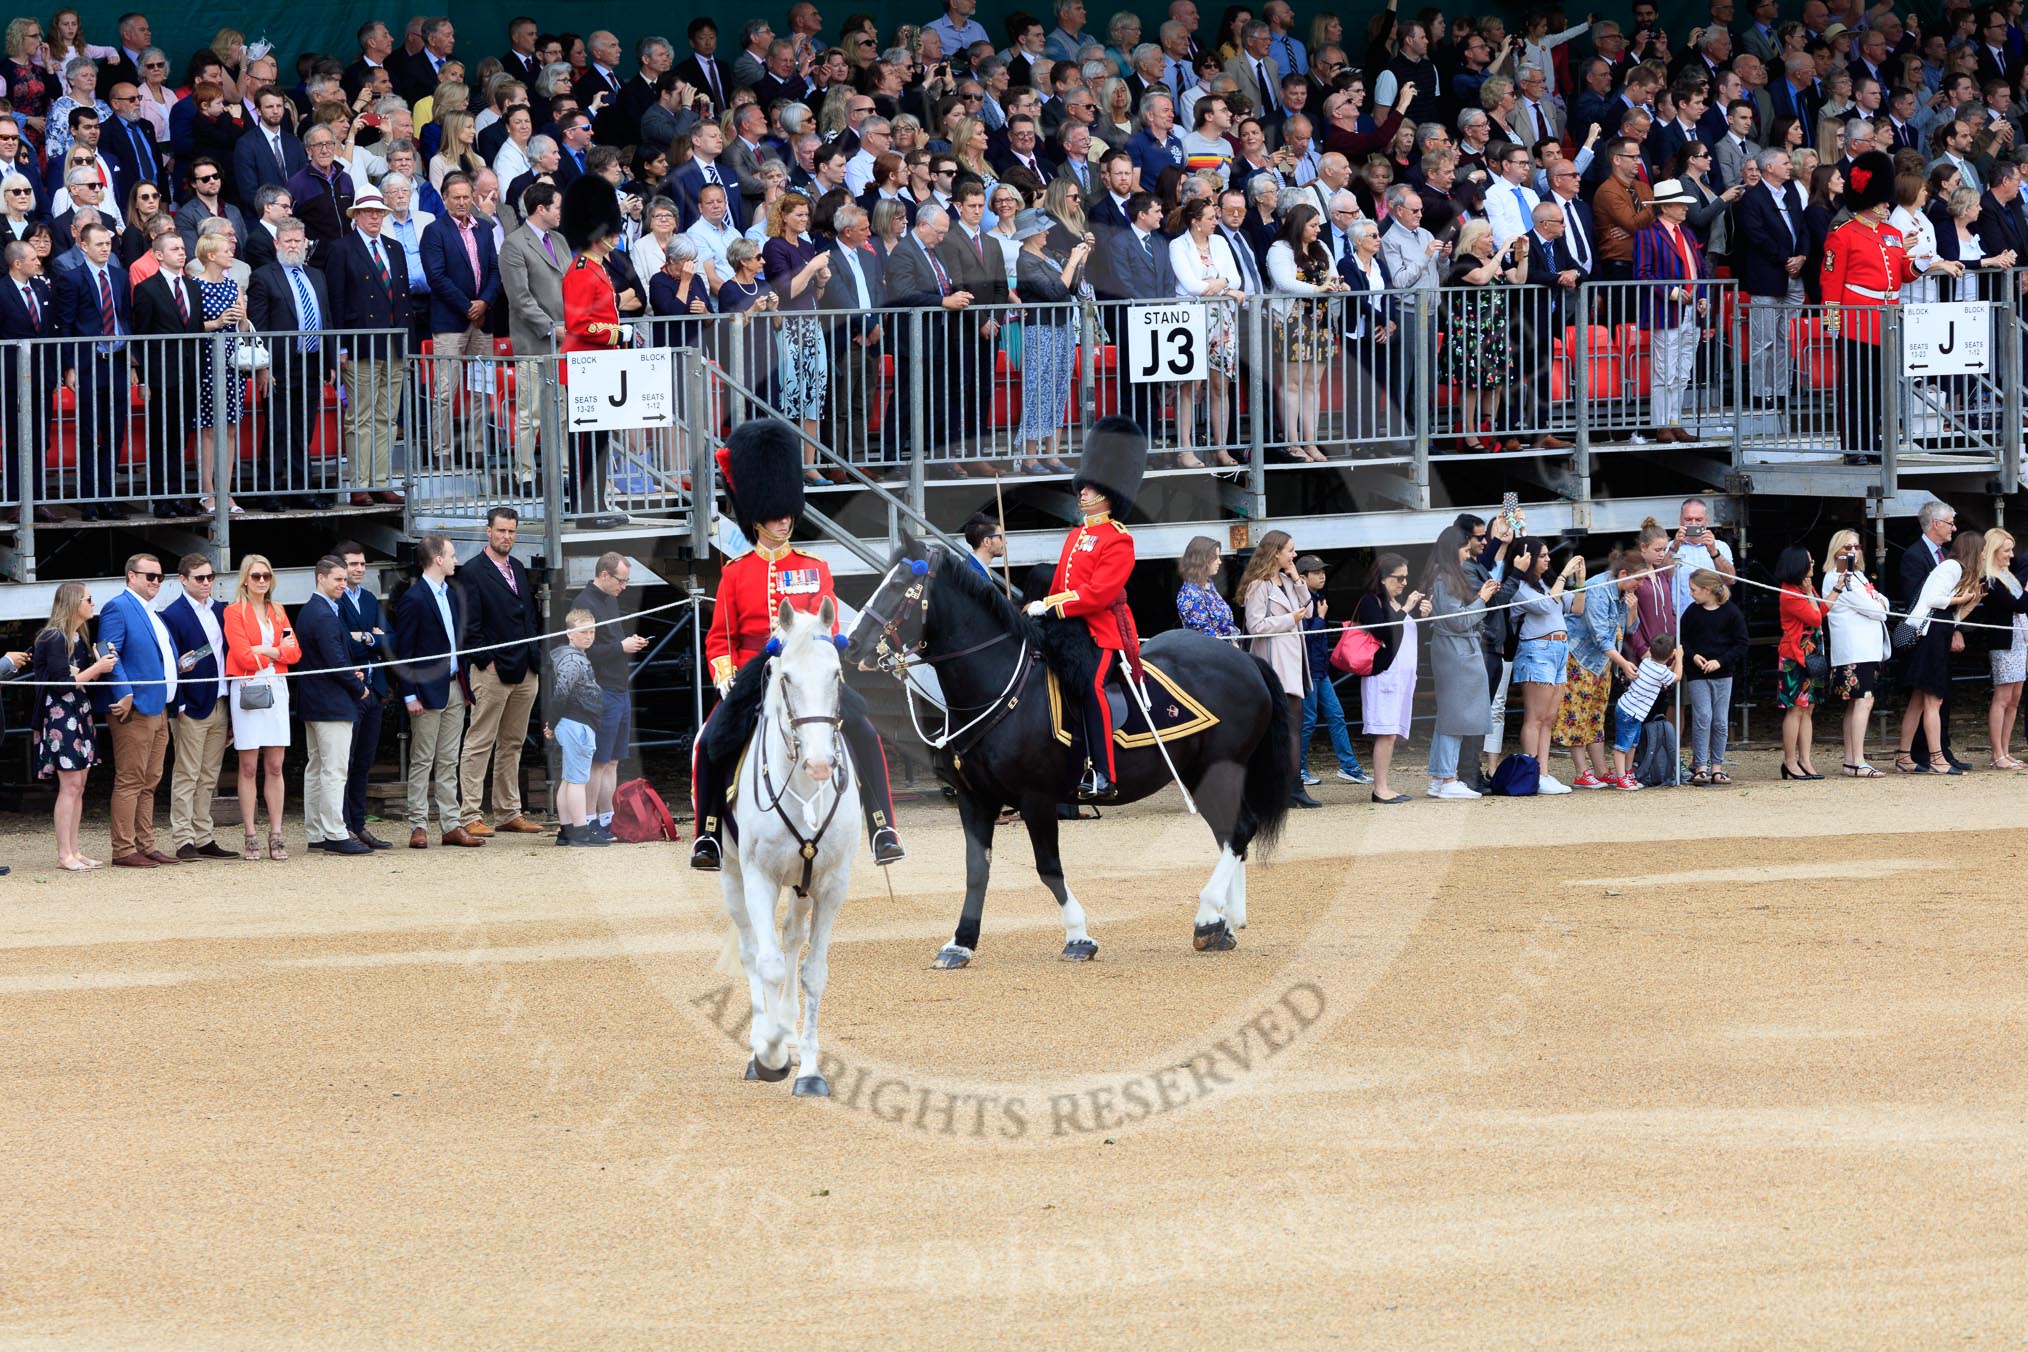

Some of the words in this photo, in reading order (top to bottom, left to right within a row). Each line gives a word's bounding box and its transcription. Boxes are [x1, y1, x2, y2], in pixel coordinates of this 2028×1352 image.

[1144, 311, 1190, 325] STAND
[1939, 321, 1954, 355] J
[1142, 327, 1195, 376] J3
[608, 370, 627, 408] J
[641, 393, 665, 401] SEATS
[646, 402, 661, 410] 1-12
